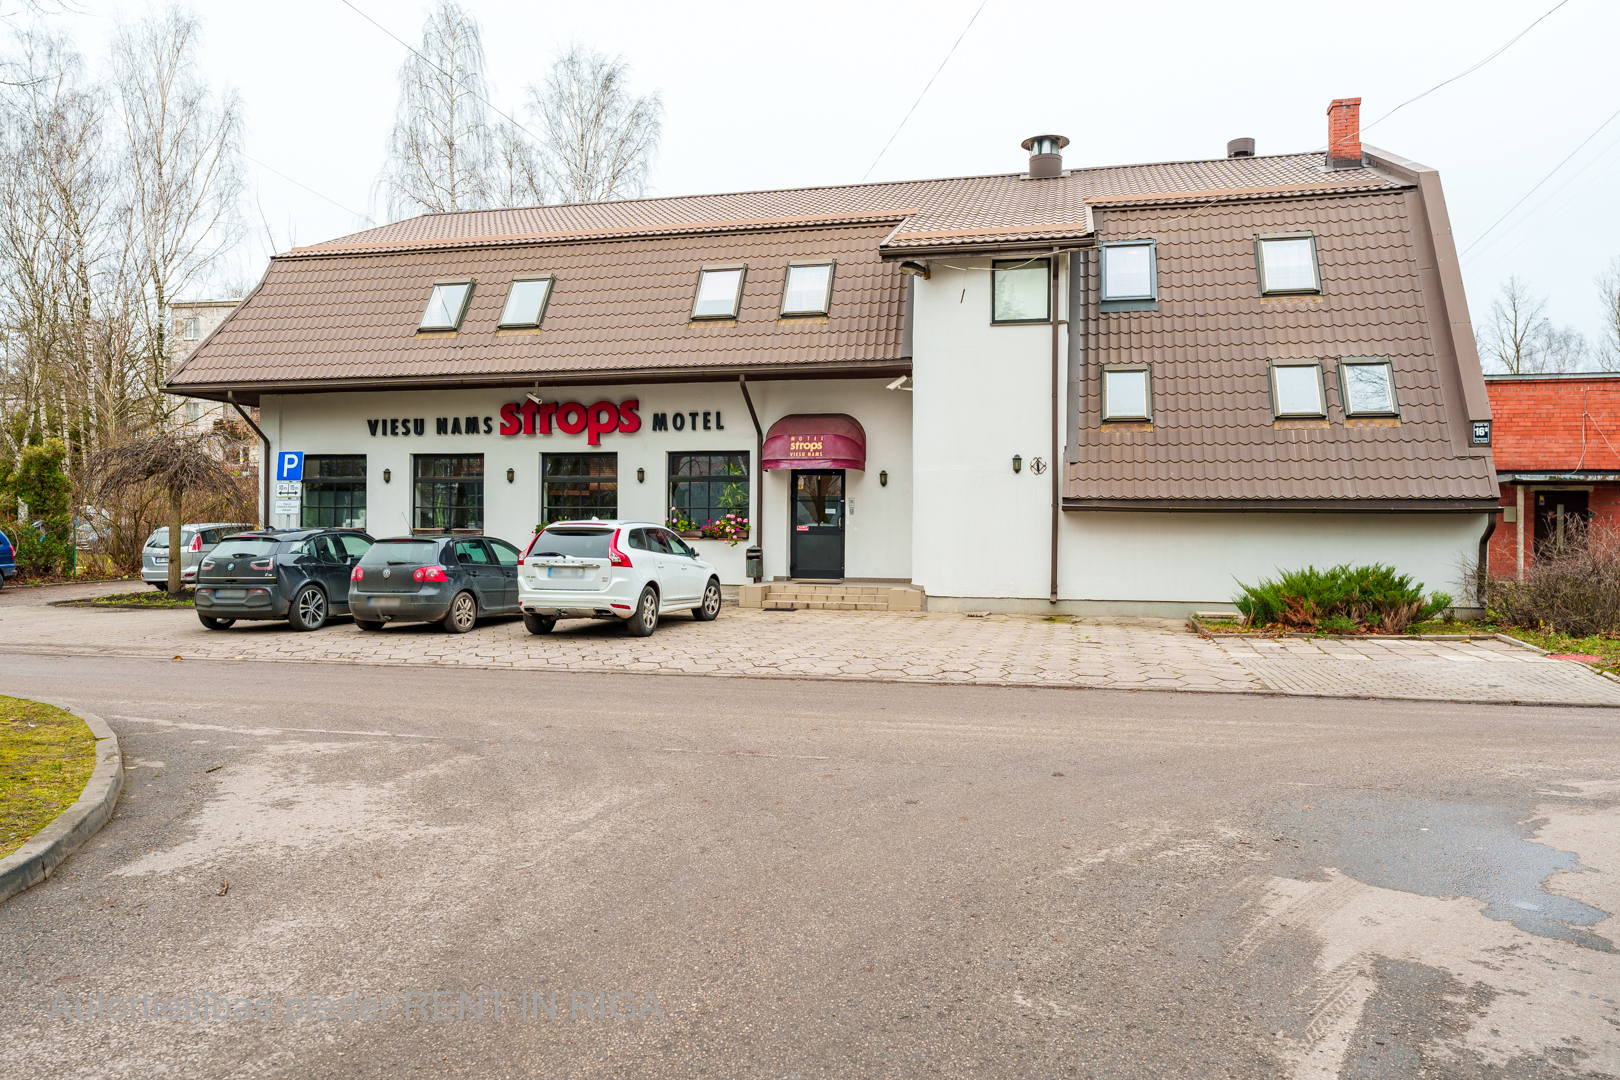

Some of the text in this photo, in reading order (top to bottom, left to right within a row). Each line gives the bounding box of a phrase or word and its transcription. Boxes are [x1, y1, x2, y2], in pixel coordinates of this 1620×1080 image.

[366, 416, 493, 437] VIESU NAMS
[499, 398, 642, 446] strops
[652, 411, 725, 432] MOTEL
[790, 441, 823, 452] strops
[283, 454, 298, 477] P
